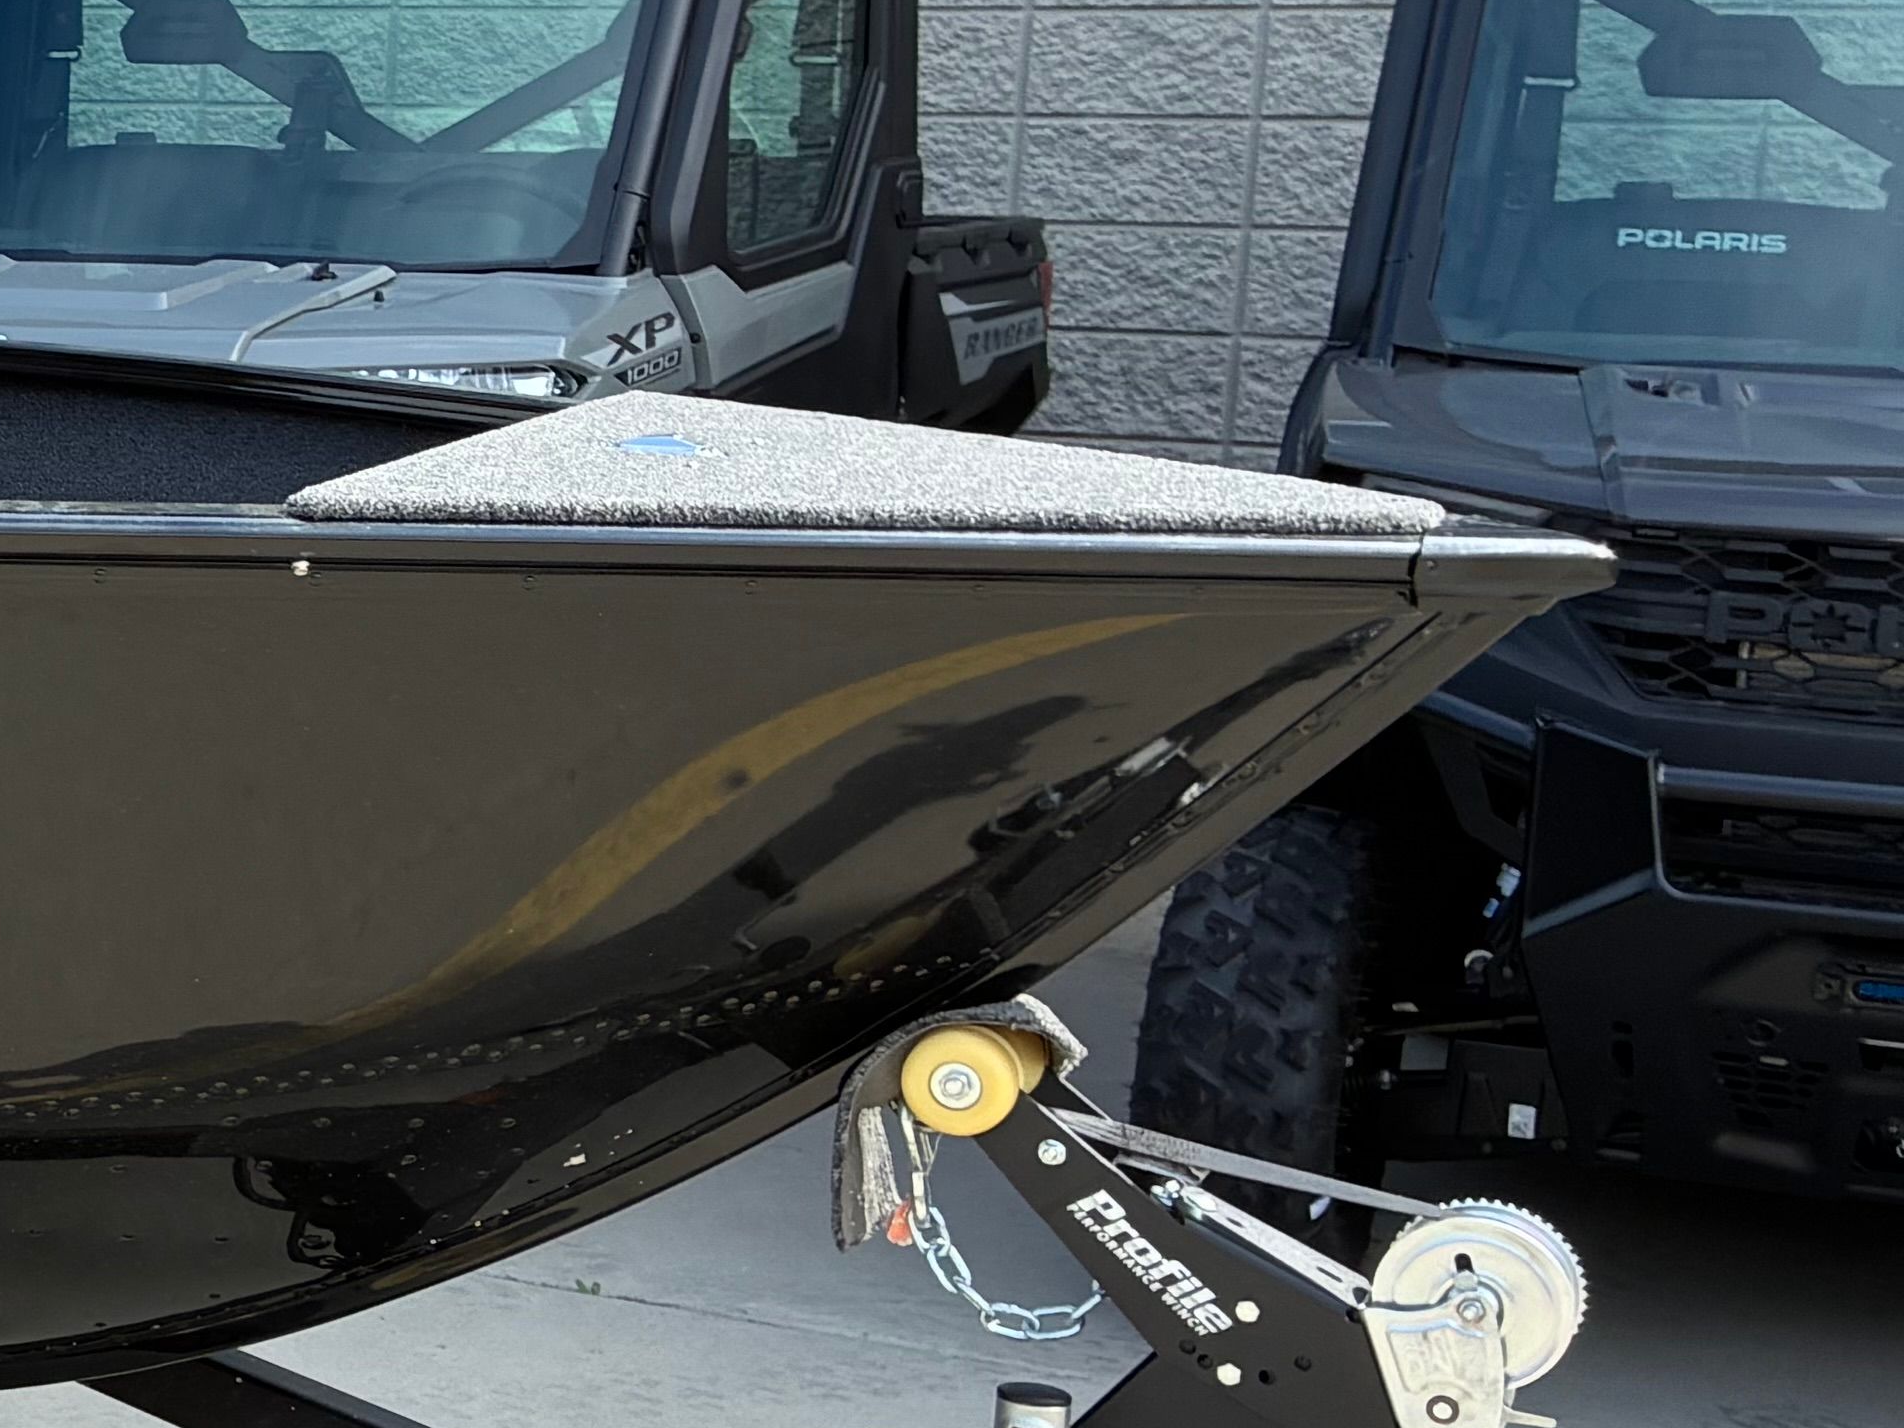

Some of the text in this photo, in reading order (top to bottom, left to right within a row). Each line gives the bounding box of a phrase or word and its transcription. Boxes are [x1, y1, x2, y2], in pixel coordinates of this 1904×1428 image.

[1617, 227, 1787, 254] POLARIS
[606, 311, 676, 368] XP
[963, 316, 1039, 361] RANGER
[627, 350, 680, 385] 1000
[1065, 1202, 1210, 1337] PERFORMANCE WINCH
[1076, 1188, 1234, 1334] Profile
